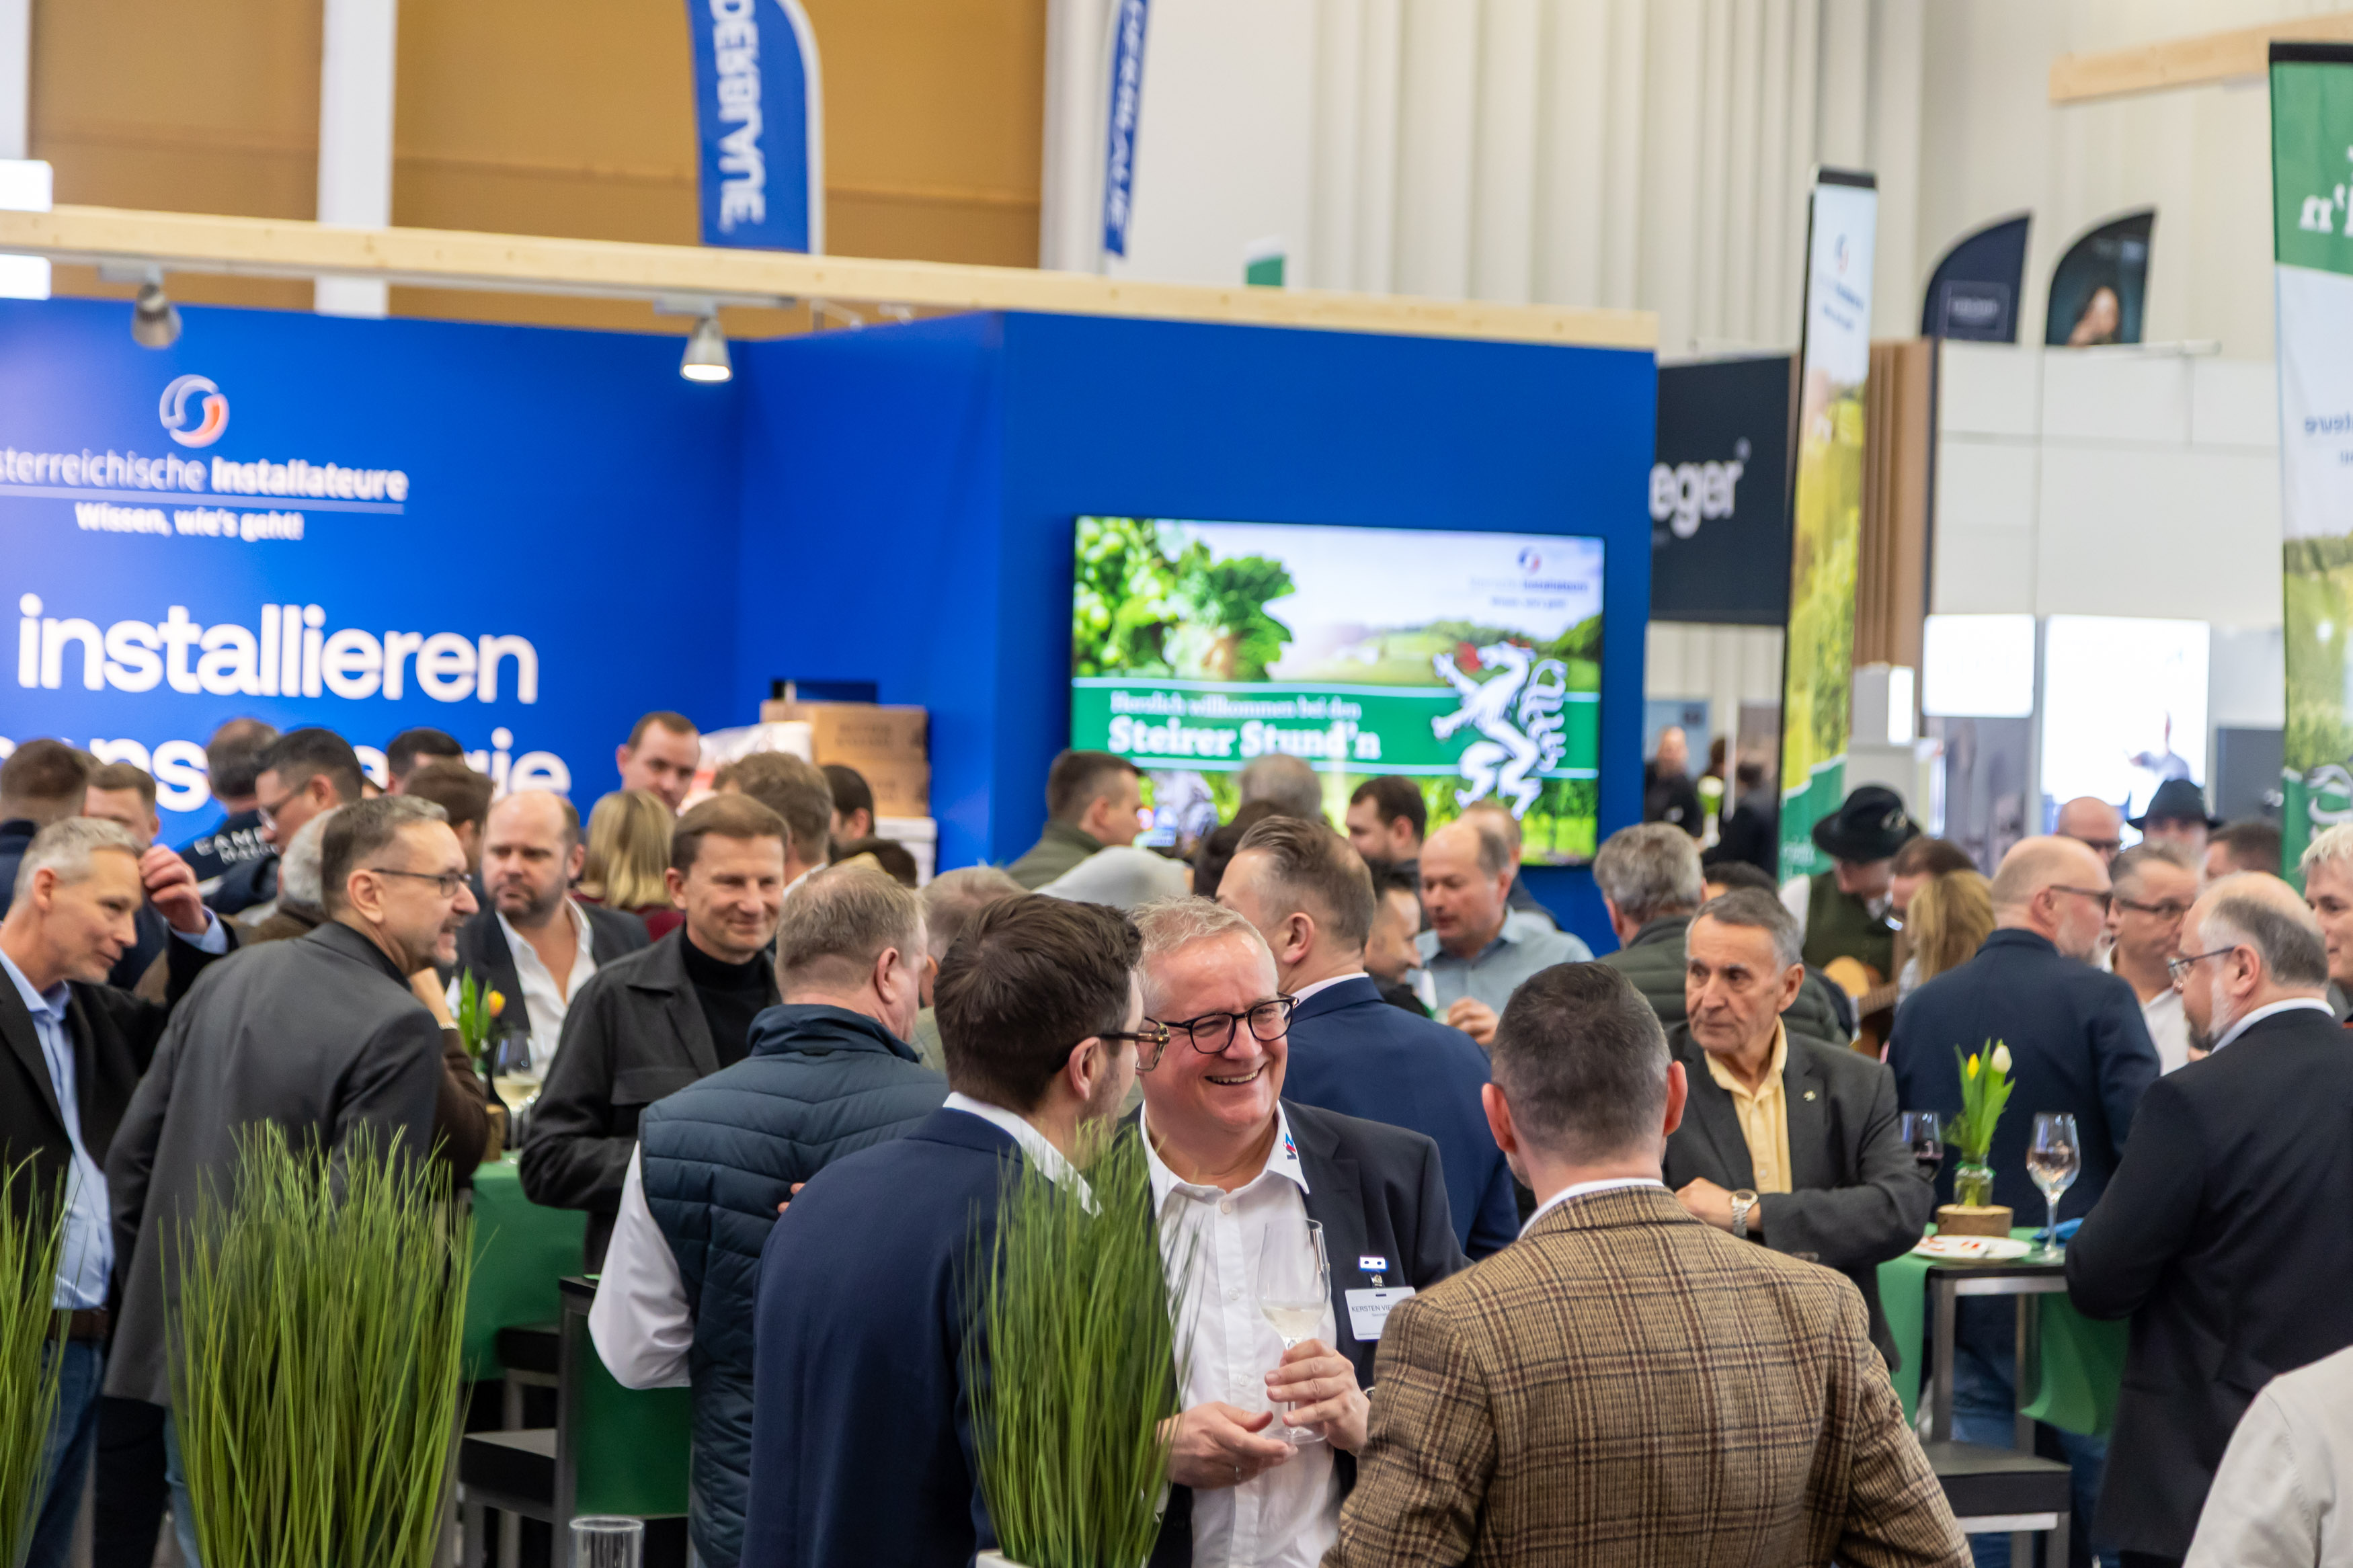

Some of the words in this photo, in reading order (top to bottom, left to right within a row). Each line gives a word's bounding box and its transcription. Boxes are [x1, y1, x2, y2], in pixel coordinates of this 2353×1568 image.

[211, 456, 409, 501] Installateure
[75, 501, 172, 538] Wissen,
[173, 506, 239, 538] wie's
[239, 510, 305, 542] geht!
[18, 593, 539, 704] installieren
[1110, 690, 1187, 716] Herzlich
[1187, 694, 1297, 719] willkommen
[1297, 694, 1327, 719] bei
[1327, 695, 1362, 720] den
[1107, 714, 1238, 757] Steirer
[1239, 719, 1382, 759] Stund'n
